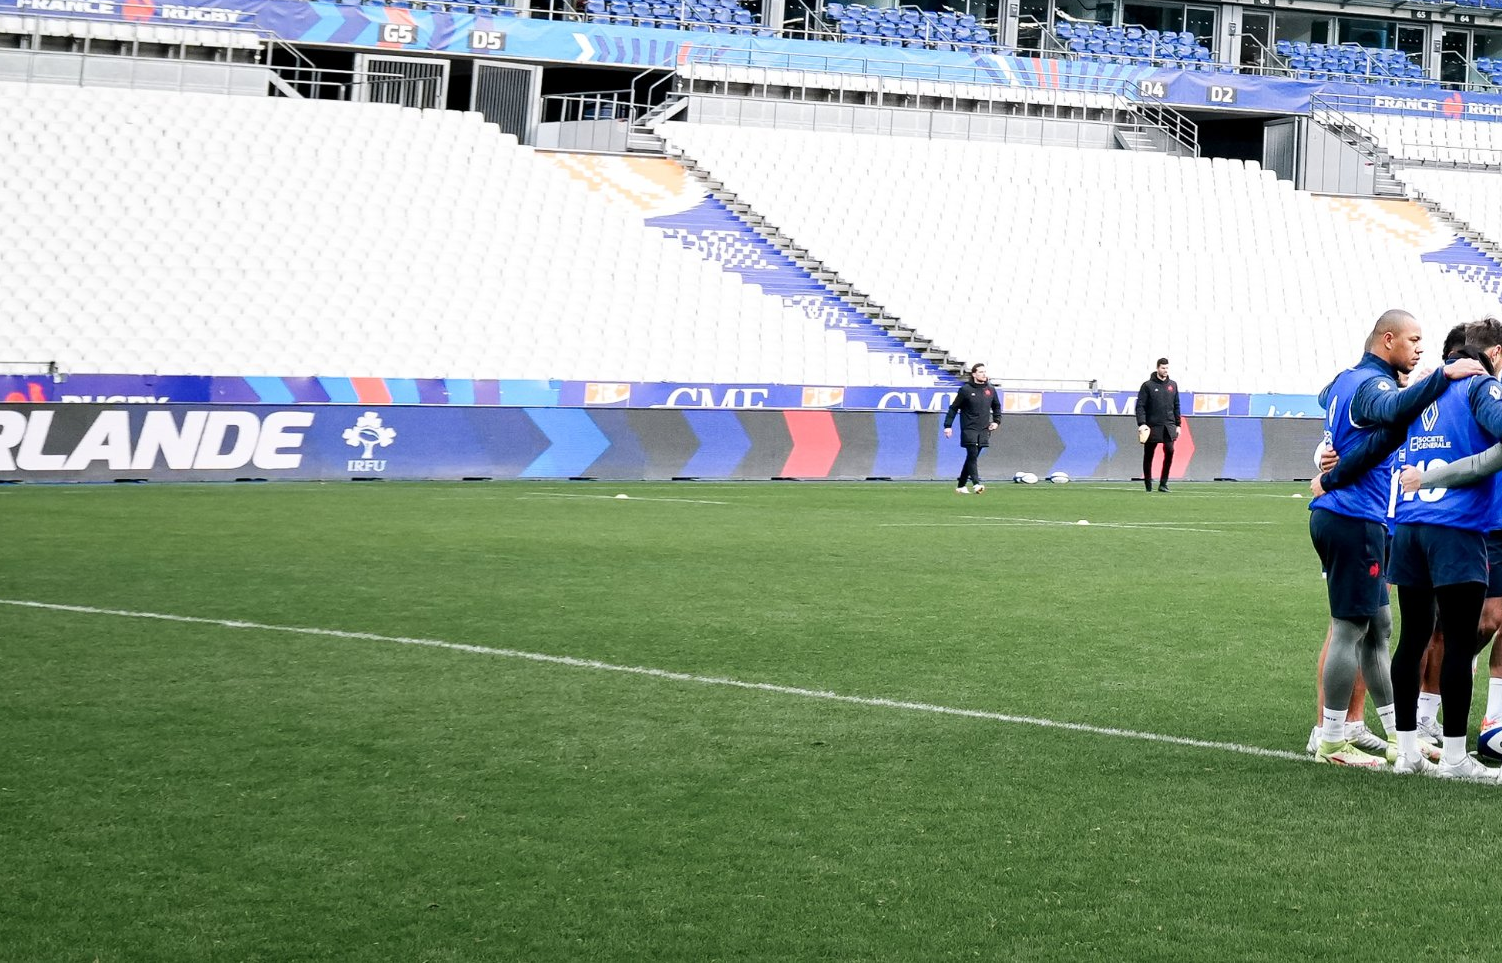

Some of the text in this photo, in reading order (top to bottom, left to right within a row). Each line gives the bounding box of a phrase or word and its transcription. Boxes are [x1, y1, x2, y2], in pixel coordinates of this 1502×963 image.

[162, 4, 239, 24] RUGBY
[1416, 11, 1426, 19] 65
[384, 24, 413, 44] G5
[472, 30, 501, 50] D5
[1140, 80, 1165, 98] D4
[1211, 85, 1233, 103] D2
[1374, 95, 1437, 111] FRANCE
[347, 460, 387, 472] IRFU
